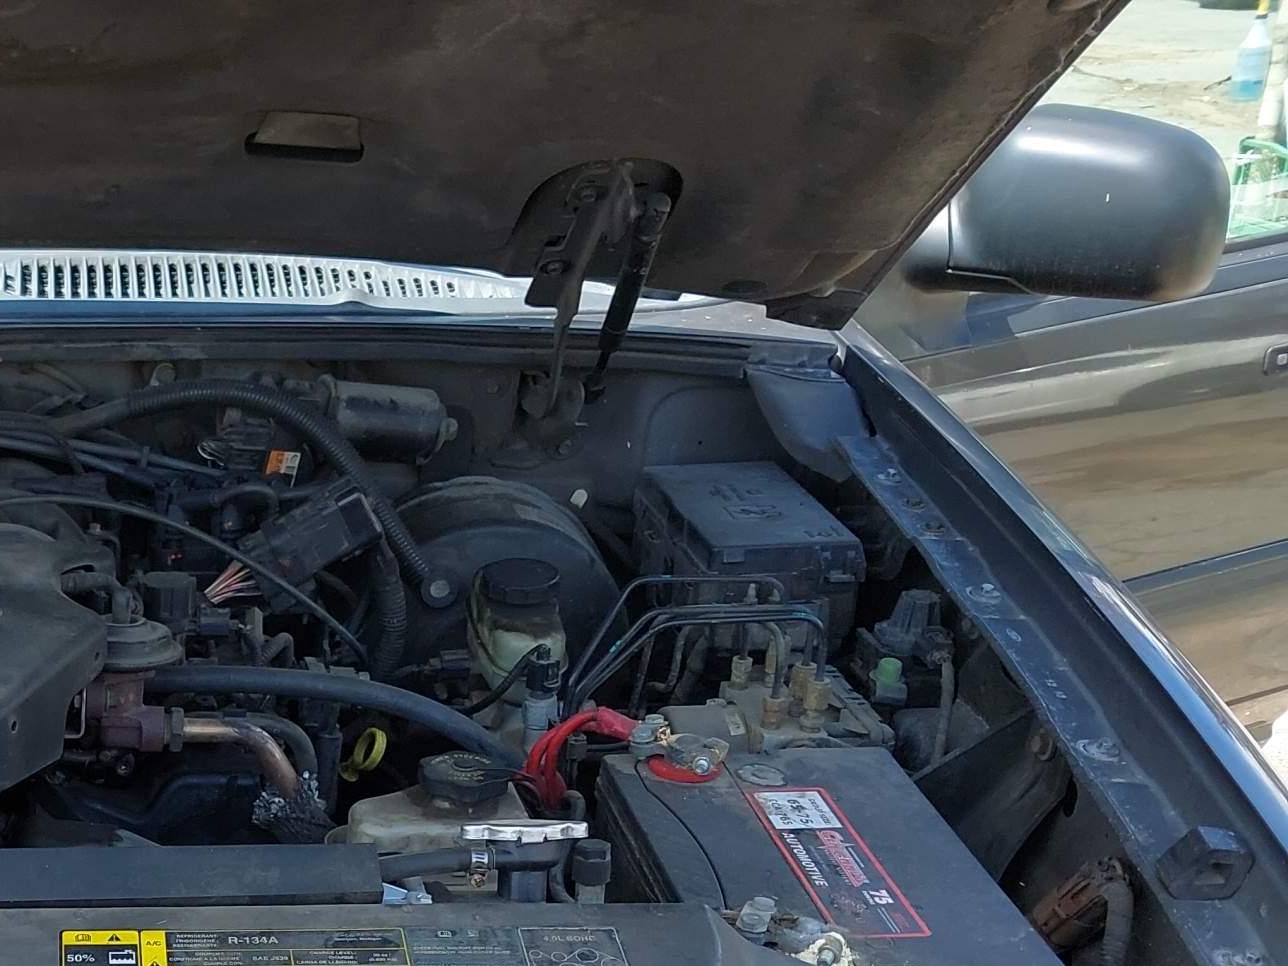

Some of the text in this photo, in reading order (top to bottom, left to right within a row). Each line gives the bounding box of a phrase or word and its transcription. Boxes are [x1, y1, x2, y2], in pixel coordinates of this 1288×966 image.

[781, 832, 829, 888] AUTOMOTIVE
[868, 889, 895, 905] 75
[66, 954, 95, 963] 50%
